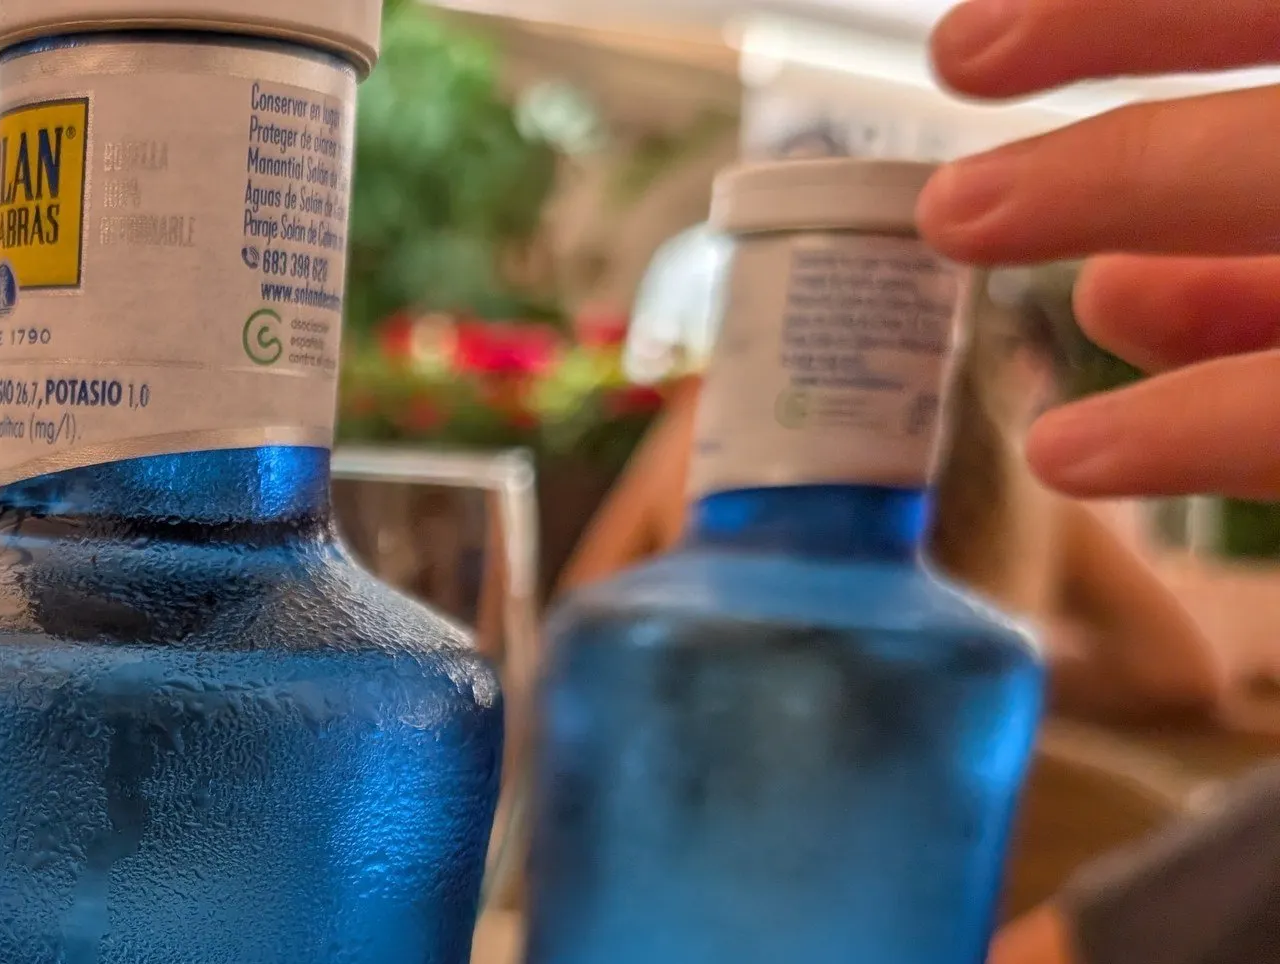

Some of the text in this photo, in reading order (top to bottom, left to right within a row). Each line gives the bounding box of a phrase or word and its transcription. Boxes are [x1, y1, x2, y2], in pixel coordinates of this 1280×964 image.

[250, 82, 308, 118] Conservar
[309, 103, 321, 121] en
[248, 114, 298, 154] Proteger
[300, 124, 312, 151] de
[246, 146, 304, 181] Manantial
[244, 178, 281, 214] Aguas
[284, 183, 297, 211] de
[243, 208, 278, 246] Paraje
[281, 213, 306, 243] Solán
[307, 219, 317, 246] de
[262, 249, 287, 276] 683
[290, 252, 310, 280] 398
[10, 328, 51, 346] 1790
[45, 379, 123, 406] POTASIO
[128, 383, 150, 411] 1,0
